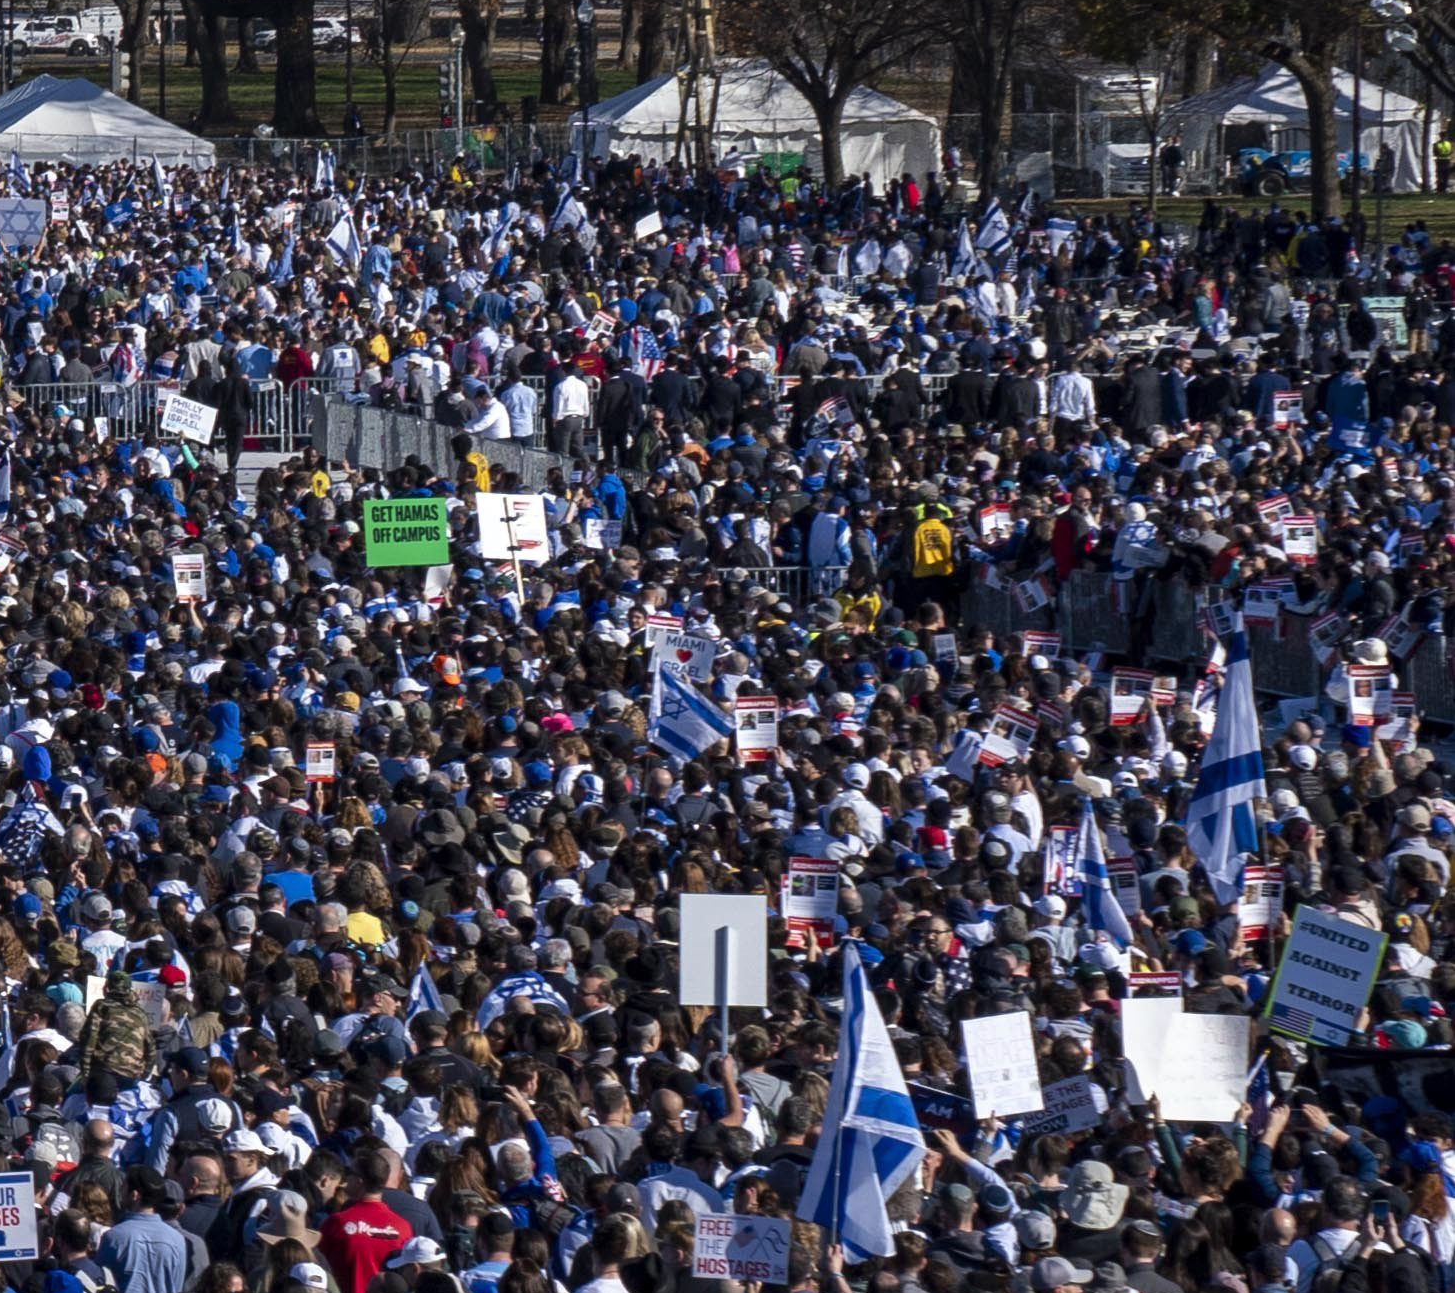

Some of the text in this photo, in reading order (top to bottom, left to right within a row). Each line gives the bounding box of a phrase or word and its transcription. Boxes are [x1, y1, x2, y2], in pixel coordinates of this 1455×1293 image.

[171, 398, 203, 414] PHILLY
[167, 413, 199, 431] ISRAEL
[372, 504, 439, 523] GET HAMAS
[372, 525, 440, 544] OFF CAMPUS
[665, 635, 707, 652] MIAMI
[1299, 920, 1370, 953] #UNITED
[1288, 949, 1363, 983] AGAINST
[1286, 983, 1358, 1016] TERROR
[1057, 1081, 1083, 1098] THE
[1024, 1096, 1092, 1125] HOSTAGES
[699, 1219, 732, 1237] FREE
[698, 1238, 724, 1255] THE
[697, 1257, 770, 1278] HOSTAGES
